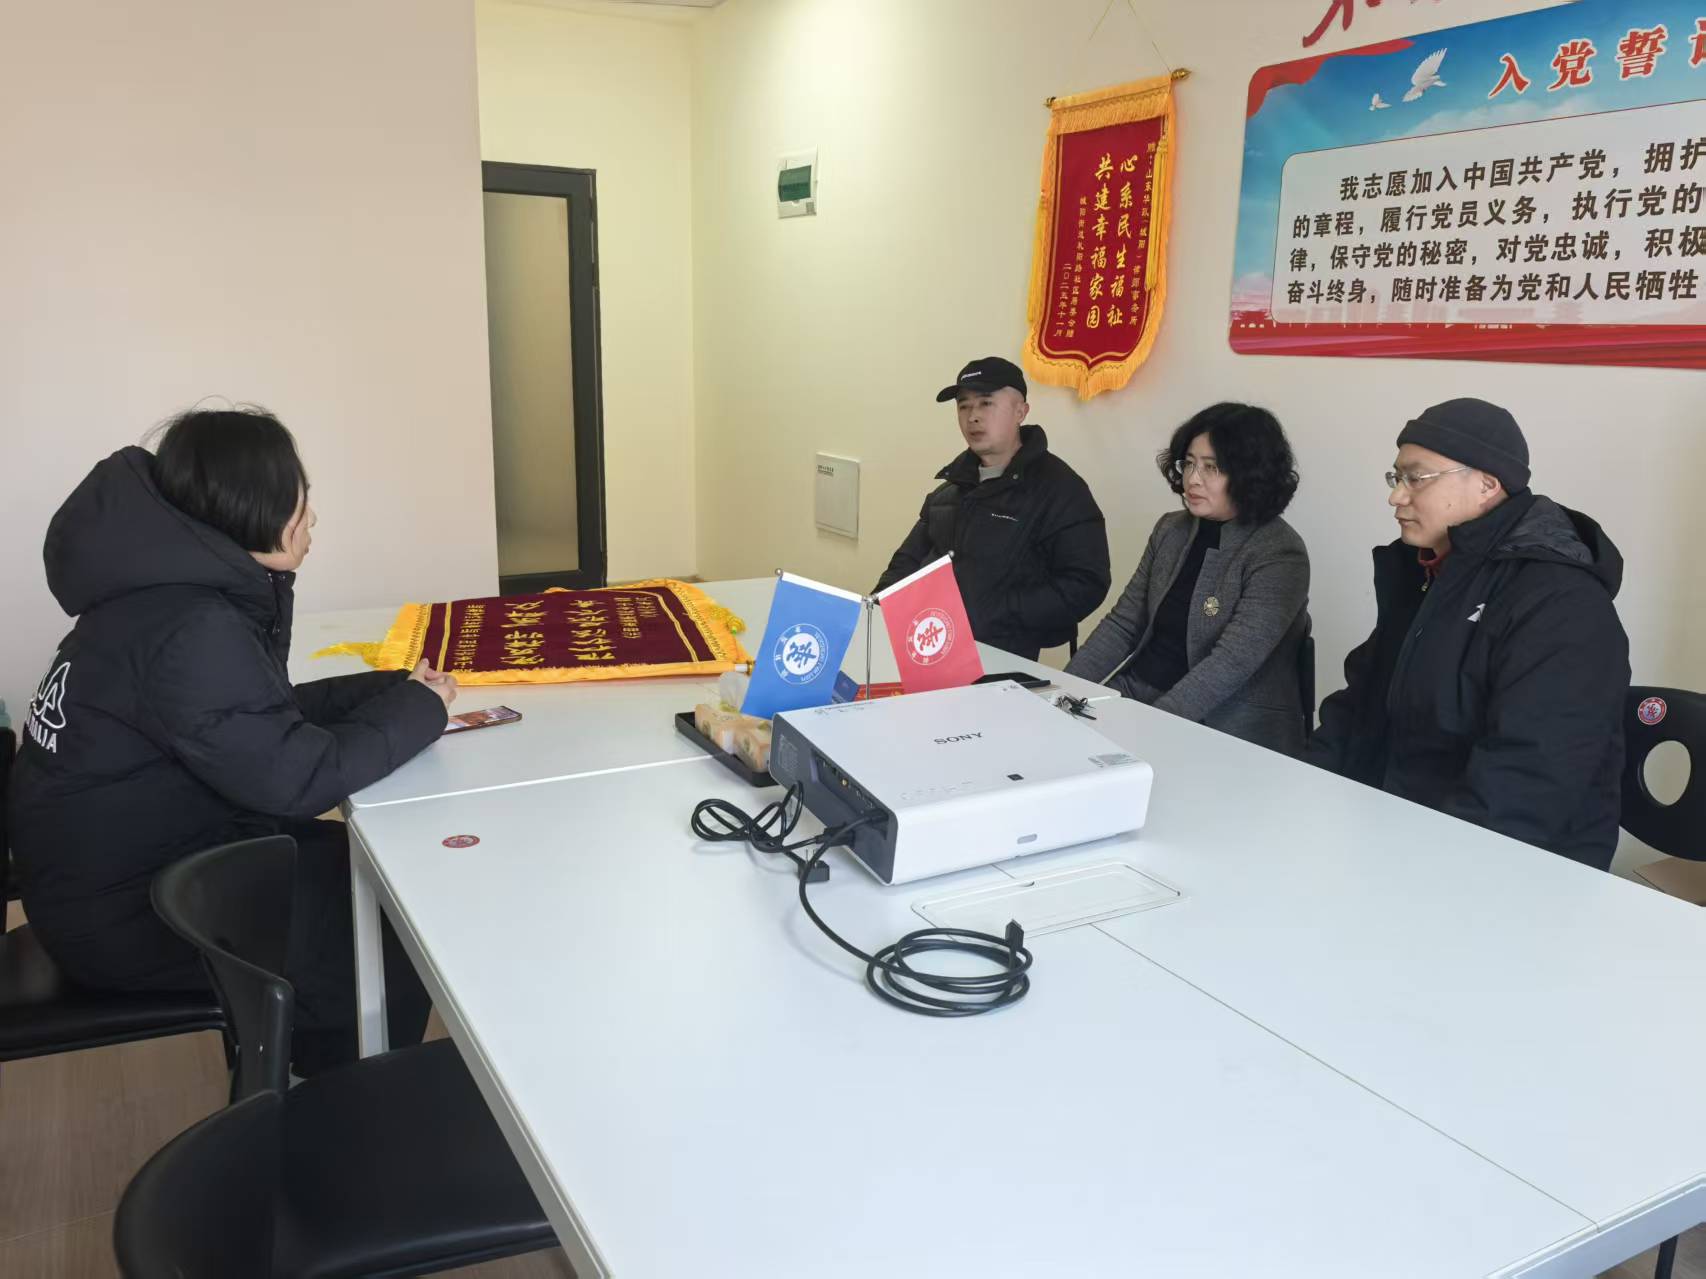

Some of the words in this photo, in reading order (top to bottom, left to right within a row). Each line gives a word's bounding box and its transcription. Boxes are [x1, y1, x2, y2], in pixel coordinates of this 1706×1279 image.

[1086, 153, 1114, 328] 共建幸福家园
[1107, 155, 1138, 327] 心系民生福祉
[934, 732, 982, 744] SONY
